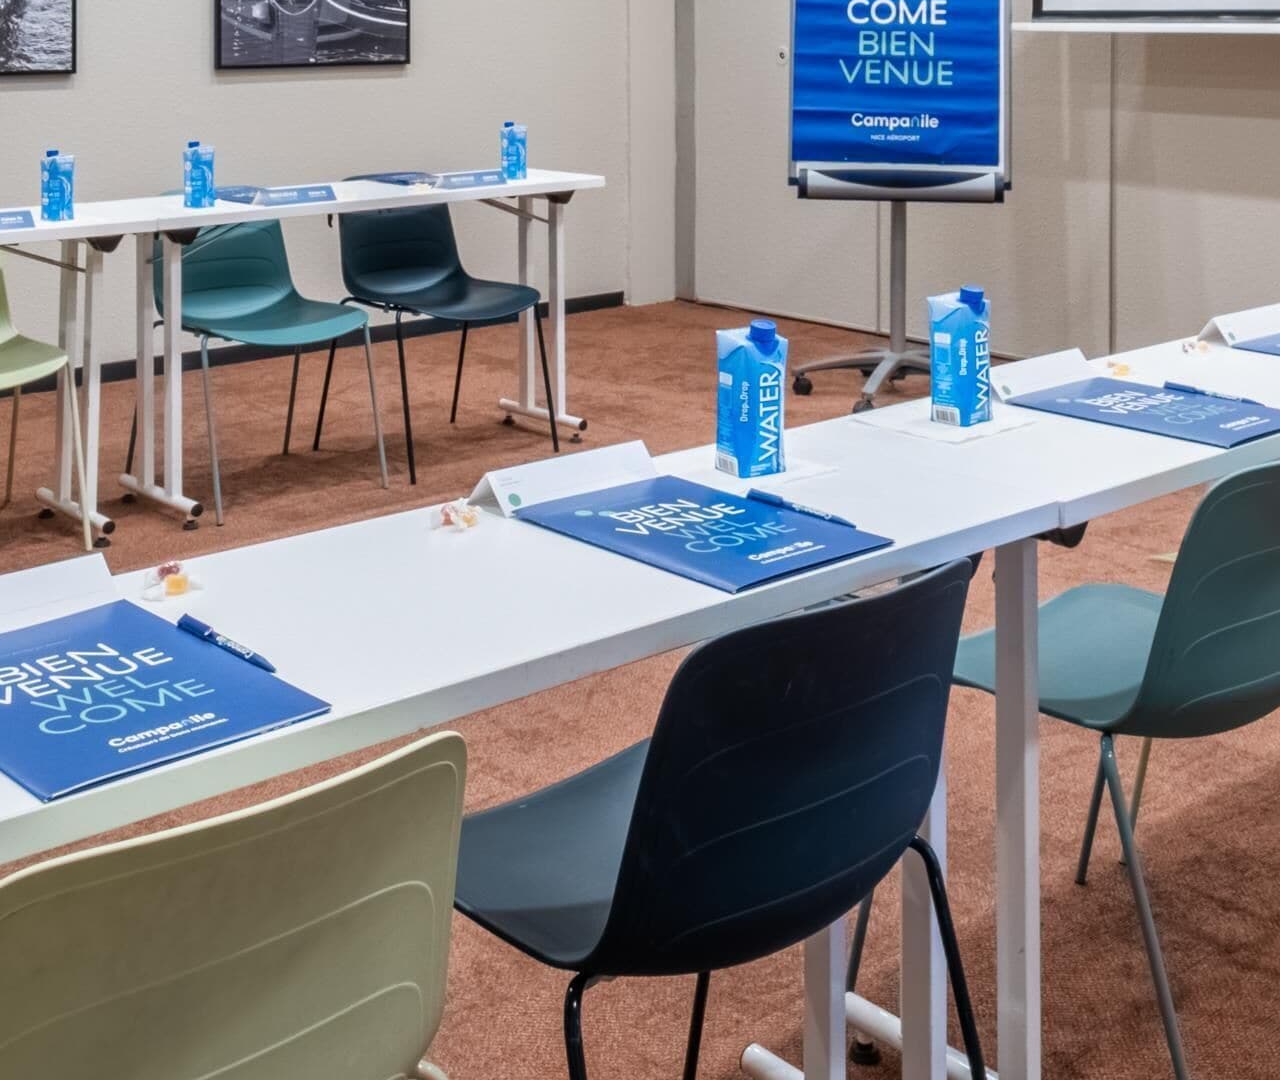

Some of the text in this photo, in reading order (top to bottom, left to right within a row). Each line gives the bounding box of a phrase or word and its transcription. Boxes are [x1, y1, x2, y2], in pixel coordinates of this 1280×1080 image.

[858, 30, 935, 56] BIEN
[839, 59, 953, 85] VENUE
[850, 112, 939, 131] Campanile
[975, 329, 990, 410] WATER
[758, 370, 779, 462] WATER
[609, 498, 701, 524] BIEN
[615, 502, 746, 536] VENUE
[663, 520, 757, 541] WEL
[685, 520, 798, 553] COME
[30, 675, 170, 712] WEL
[38, 678, 216, 734] COME
[108, 711, 216, 749] Campanile
